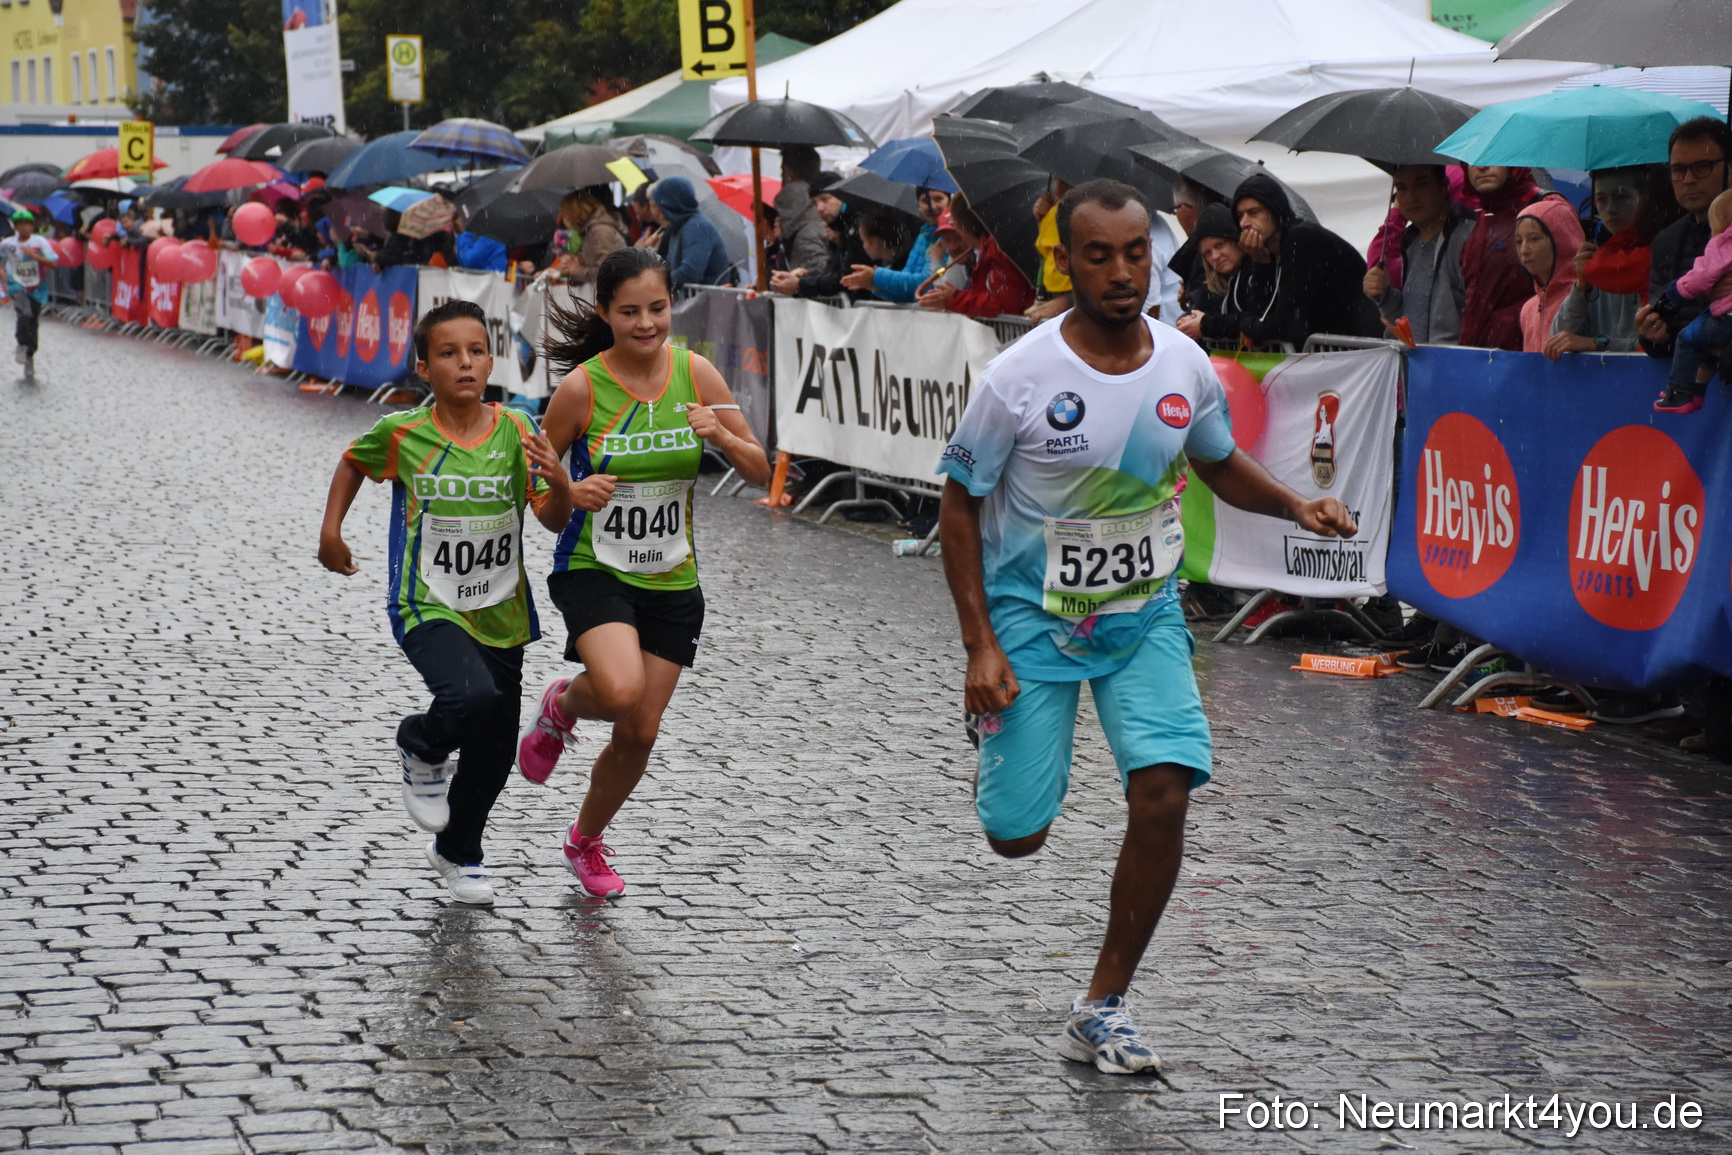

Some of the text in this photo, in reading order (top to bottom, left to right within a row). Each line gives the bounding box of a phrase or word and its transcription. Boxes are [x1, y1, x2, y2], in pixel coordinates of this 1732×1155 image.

[699, 0, 735, 53] B
[127, 136, 144, 162] C
[1049, 392, 1081, 408] BMW
[1161, 402, 1190, 420] Hervis
[602, 427, 698, 456] BOCK
[1046, 433, 1089, 448] PARTL
[1046, 444, 1089, 455] Neumarkt
[412, 473, 514, 502] BOCK
[642, 482, 683, 498] BOCK
[1423, 448, 1514, 565] Hervis
[430, 525, 463, 534] NeuerMarkt
[469, 513, 514, 532] BOCK
[604, 500, 680, 540] 4040
[1101, 511, 1154, 536] BOCK
[1576, 464, 1698, 592] Hervis
[1054, 530, 1094, 540] NeuerMarkt
[433, 533, 512, 576] 4048
[628, 549, 663, 564] Helin
[1059, 535, 1155, 588] 5239
[1423, 544, 1471, 571] SPORTS
[457, 579, 490, 599] Farid
[1577, 570, 1635, 599] SPORTS
[1061, 581, 1151, 614] Mohaad
[1310, 658, 1356, 672] WERBUNG
